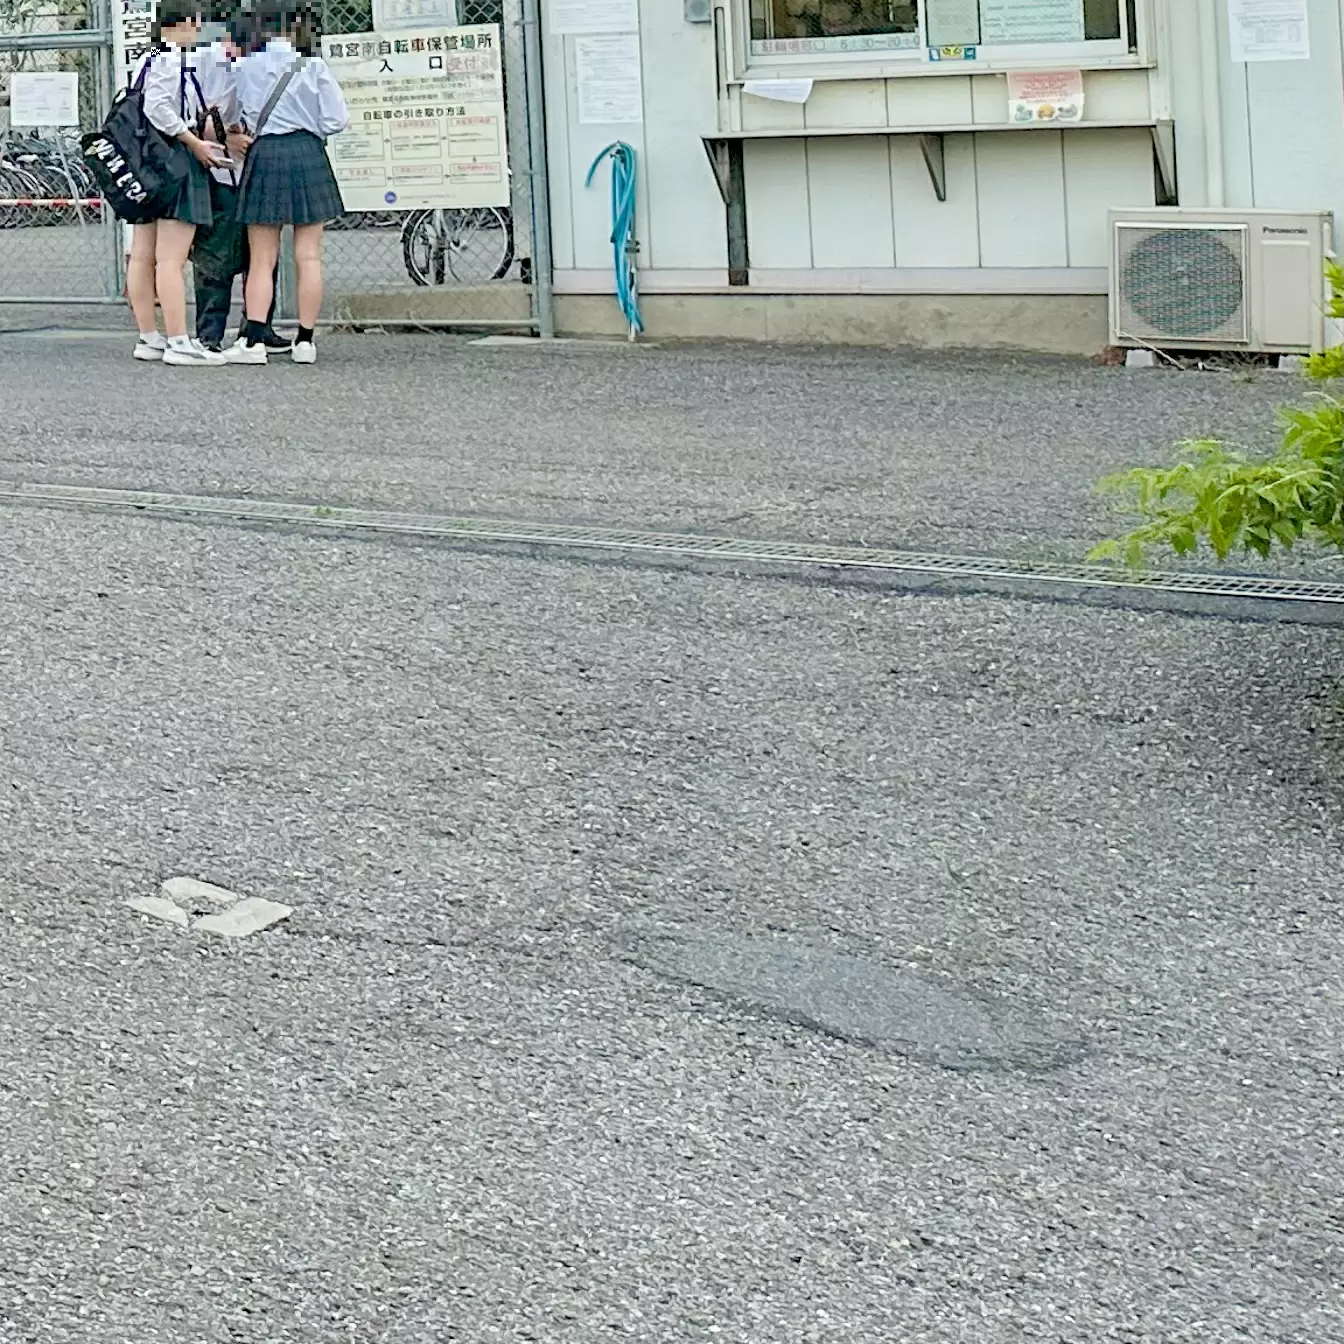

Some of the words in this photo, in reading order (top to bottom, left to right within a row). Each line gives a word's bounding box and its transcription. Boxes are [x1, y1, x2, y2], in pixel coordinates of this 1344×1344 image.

[329, 33, 493, 58] 鷺宮南自転車保管場所
[363, 106, 466, 121] 自転車の引き取り方法
[92, 138, 126, 174] NEW
[116, 172, 148, 205] ERA
